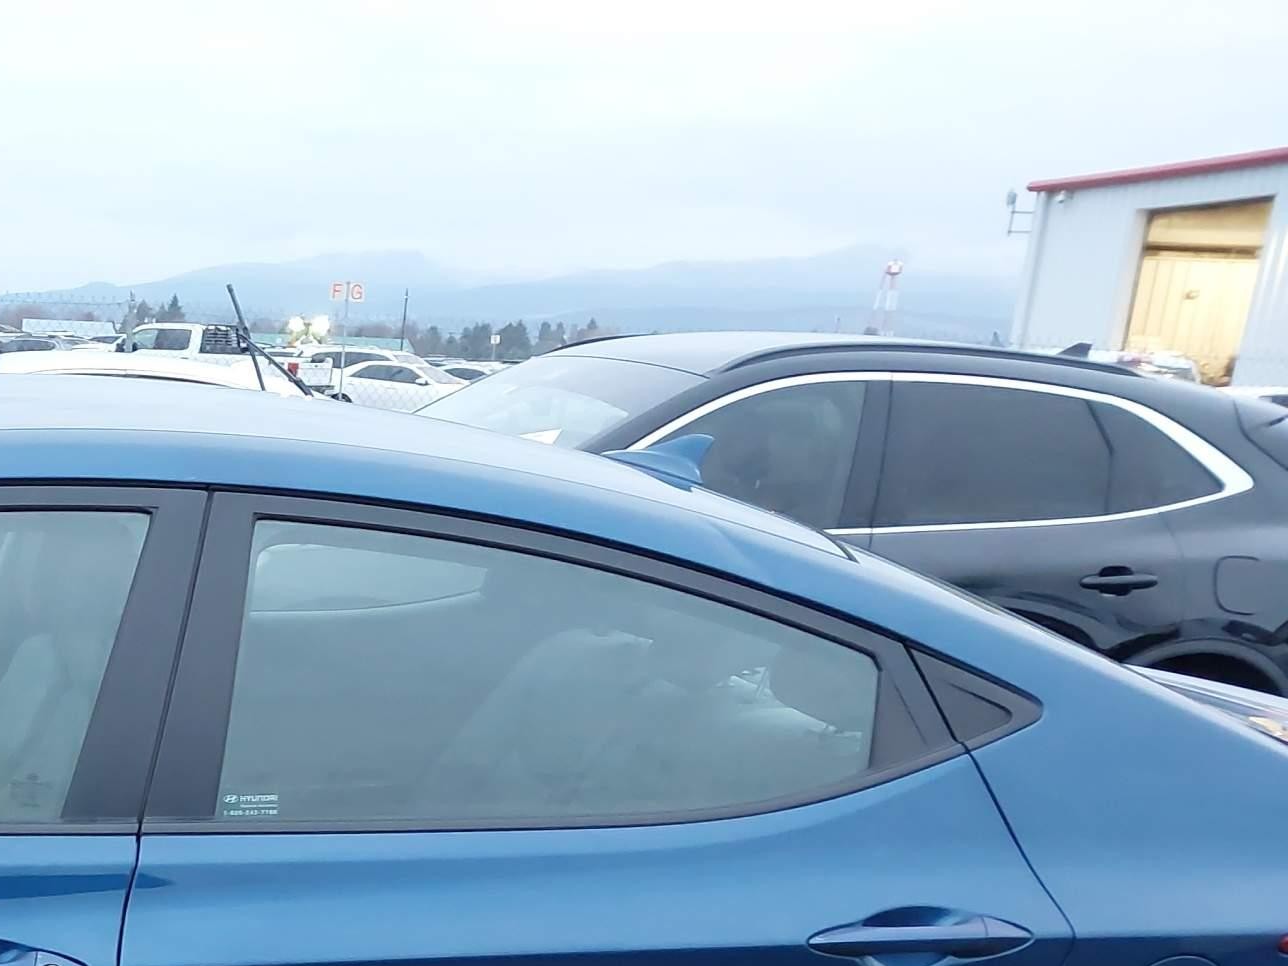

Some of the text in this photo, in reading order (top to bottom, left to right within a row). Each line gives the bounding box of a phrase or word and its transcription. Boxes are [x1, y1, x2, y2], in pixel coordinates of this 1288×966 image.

[332, 283, 363, 300] F G
[239, 794, 279, 802] HYUNDAI
